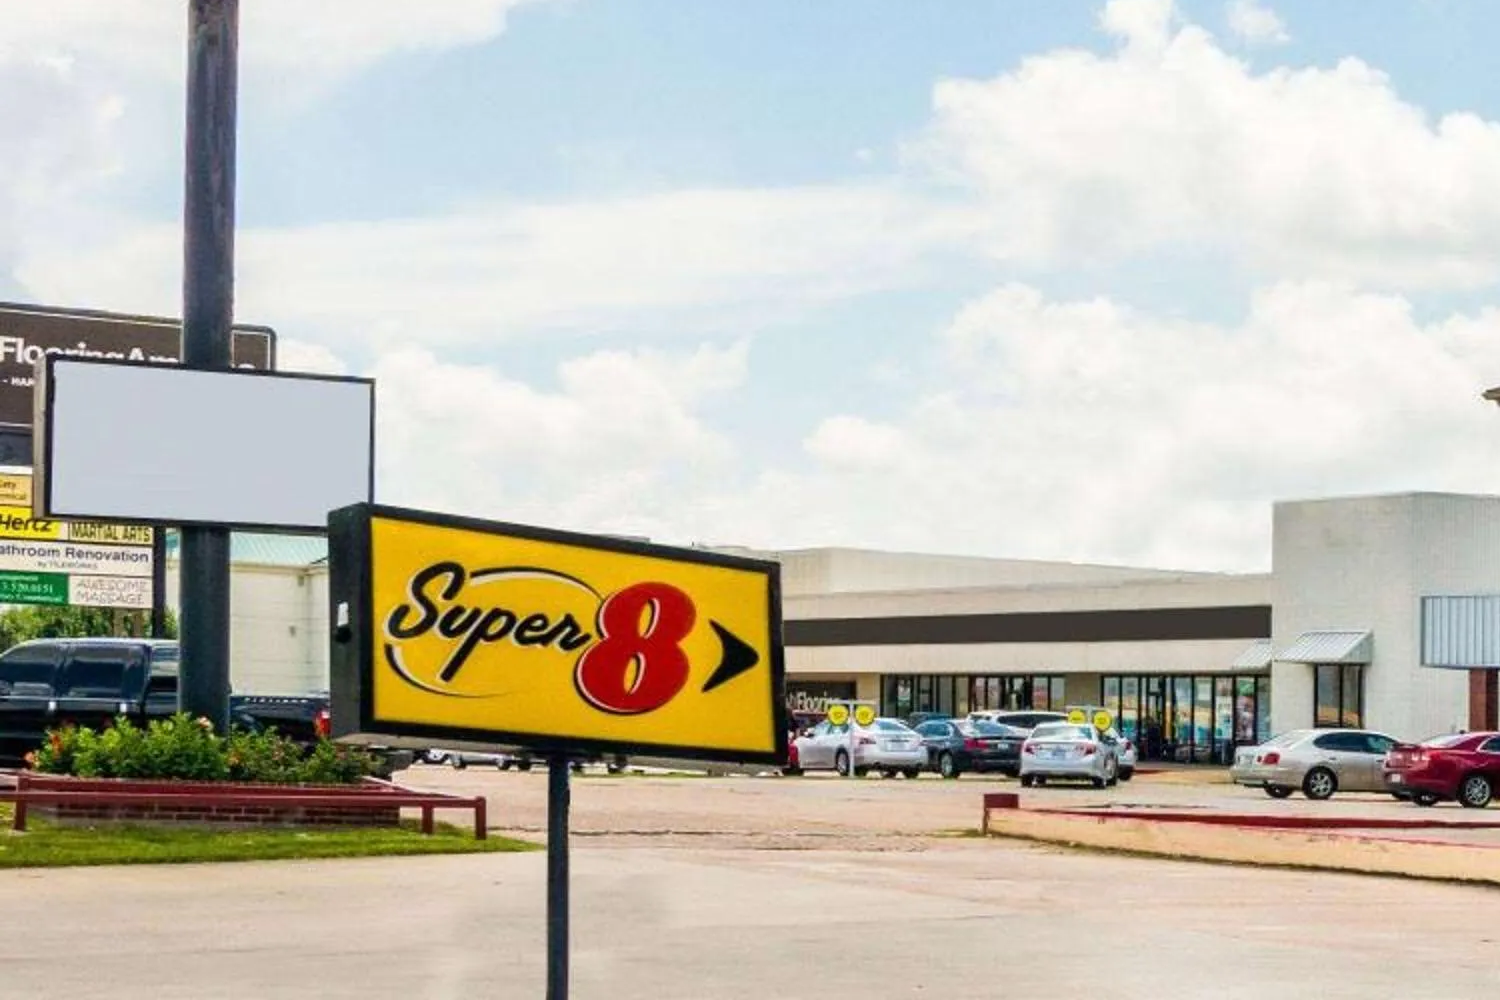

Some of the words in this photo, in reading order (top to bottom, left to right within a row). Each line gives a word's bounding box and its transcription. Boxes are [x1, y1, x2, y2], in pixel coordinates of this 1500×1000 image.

[0, 513, 53, 533] Hertz
[0, 544, 60, 557] athroom
[65, 547, 149, 563] Renovation
[386, 561, 591, 682] Super
[574, 581, 698, 717] 8
